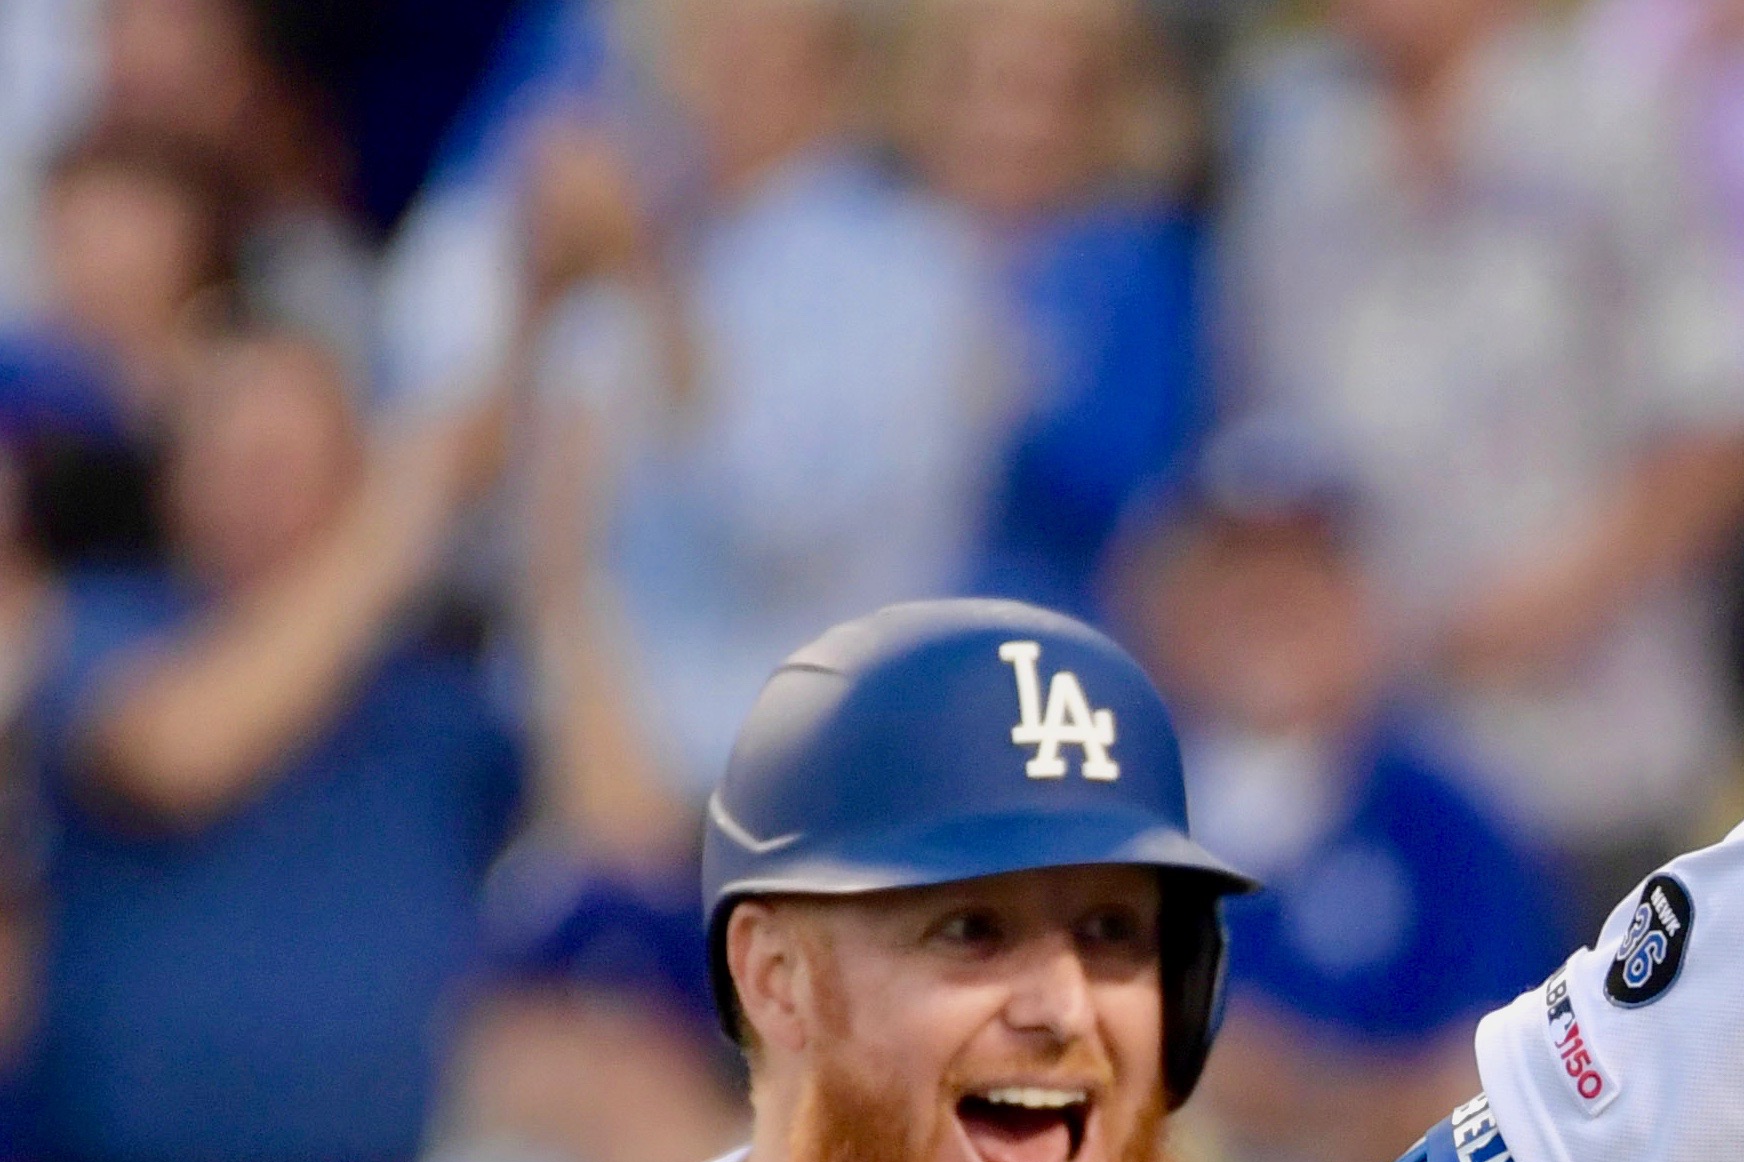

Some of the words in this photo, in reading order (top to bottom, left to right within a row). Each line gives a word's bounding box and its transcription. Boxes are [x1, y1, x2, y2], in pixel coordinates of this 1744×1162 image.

[999, 640, 1120, 781] LA
[1617, 902, 1668, 988] 36
[1650, 885, 1681, 938] NEWK
[1560, 1037, 1603, 1099] 150
